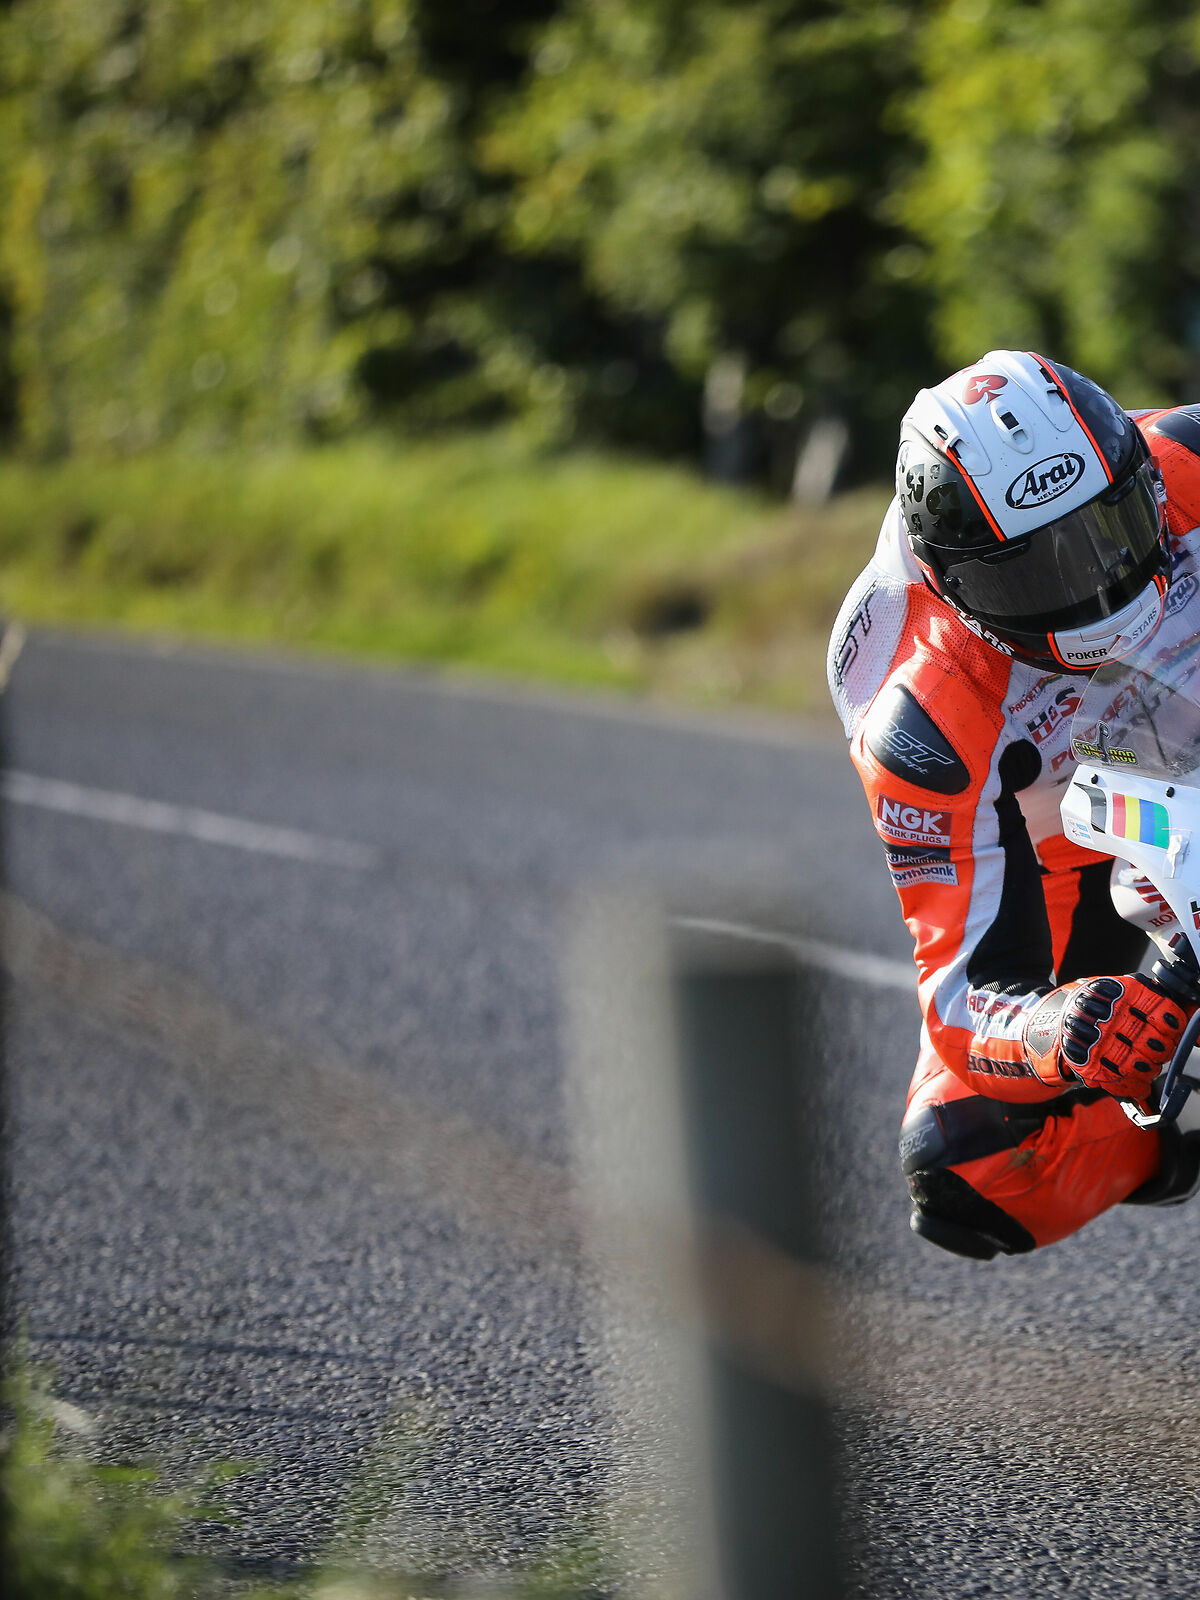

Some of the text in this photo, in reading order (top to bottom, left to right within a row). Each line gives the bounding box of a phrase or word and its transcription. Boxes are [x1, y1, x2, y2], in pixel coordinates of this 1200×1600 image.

[1014, 454, 1076, 507] Arai
[1037, 481, 1068, 502] HELMET
[1067, 608, 1157, 660] POKER STARS
[882, 798, 943, 834] NGK
[910, 834, 942, 844] PLUGS
[892, 866, 954, 881] orthbank
